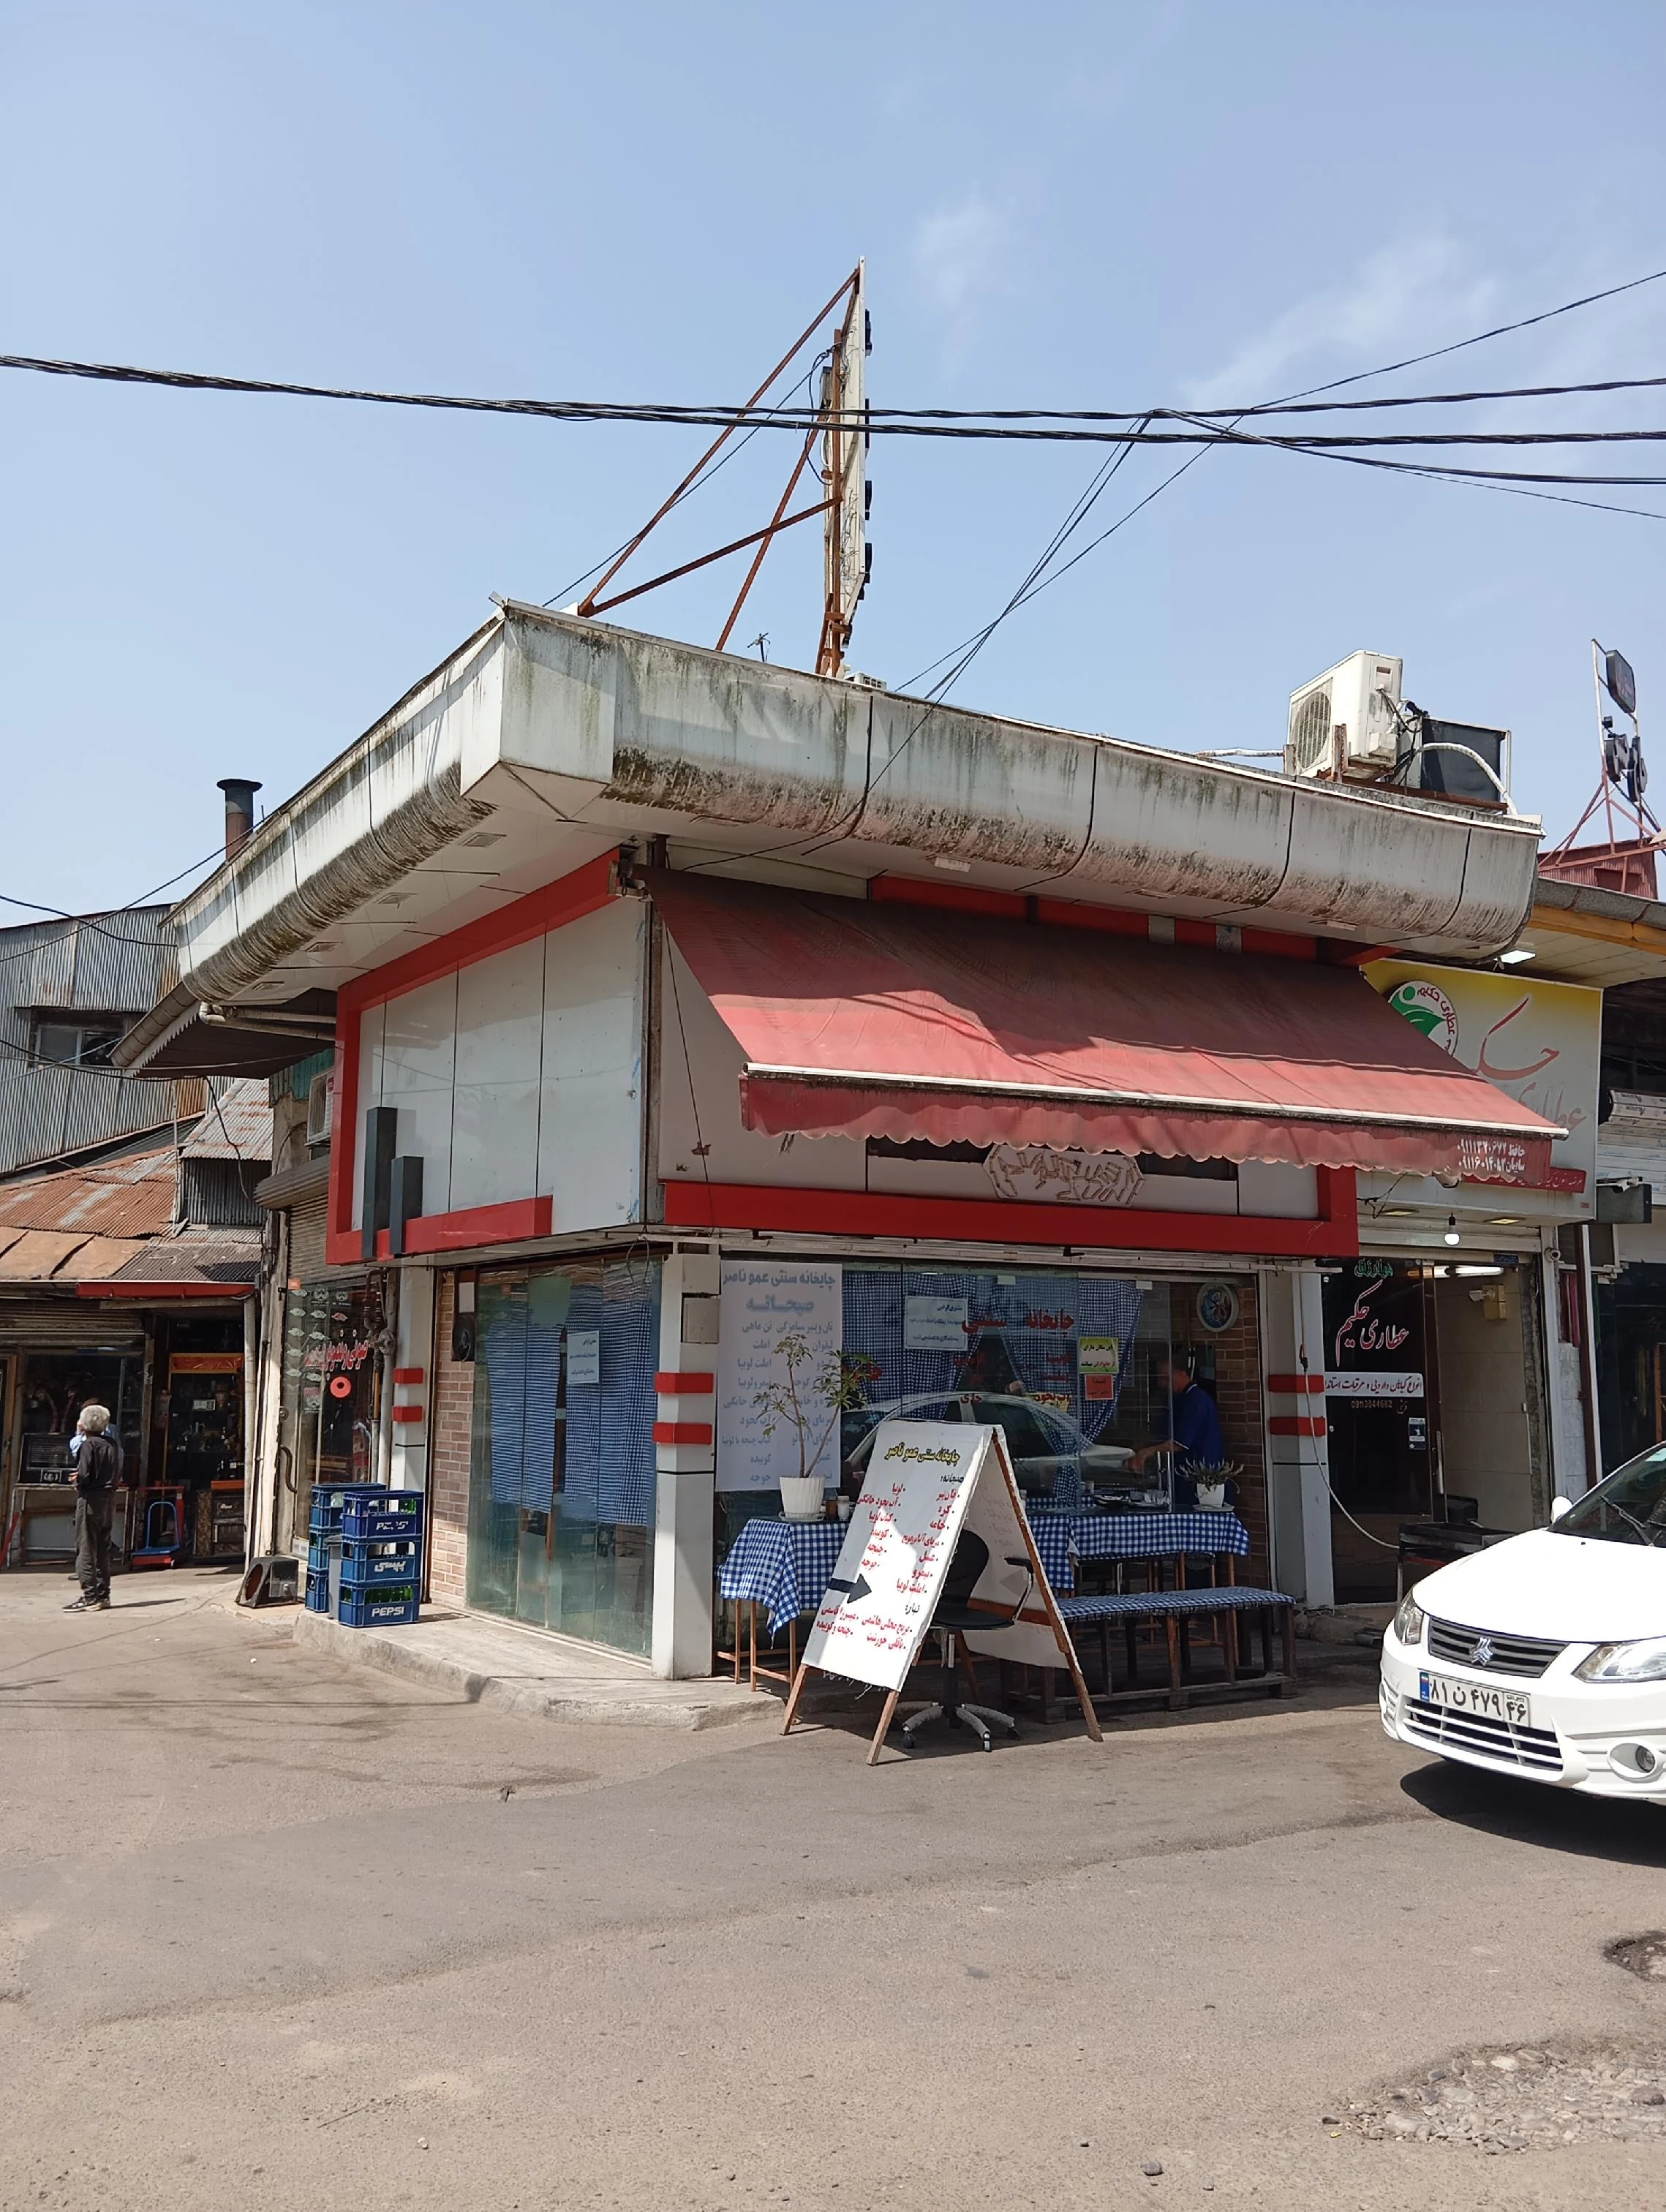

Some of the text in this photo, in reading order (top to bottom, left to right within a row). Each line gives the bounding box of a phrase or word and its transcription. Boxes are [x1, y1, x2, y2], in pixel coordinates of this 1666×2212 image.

[1416, 986, 1456, 1035] عطاری حکیم
[1508, 1143, 1526, 1157] حافظ
[723, 1268, 835, 1292] چایخانه سنتی عمو ناصر
[745, 1293, 814, 1317] صبحانه
[742, 1319, 772, 1334] تن ماهی
[961, 1306, 1075, 1335] چایخانه سنتی
[1335, 1278, 1410, 1367] عطاری حکیم
[753, 1339, 770, 1349] املت
[737, 1356, 772, 1371] املت لوبیا
[1390, 1375, 1412, 1394] گیاهان
[1407, 1378, 1422, 1394] انواع
[750, 1453, 772, 1465] کوبیده
[883, 1441, 961, 1468] چایخانه سنتی عمو ناصر
[750, 1474, 771, 1484] جوجه
[892, 1482, 904, 1495] لوبیا
[938, 1504, 952, 1517] کره
[919, 1549, 935, 1563] عسل
[374, 1560, 407, 1572] پپسی
[372, 1606, 404, 1618] PEPSI
[1431, 1678, 1527, 1723] ۸۱ ن ۴۷۹ ۴۶
